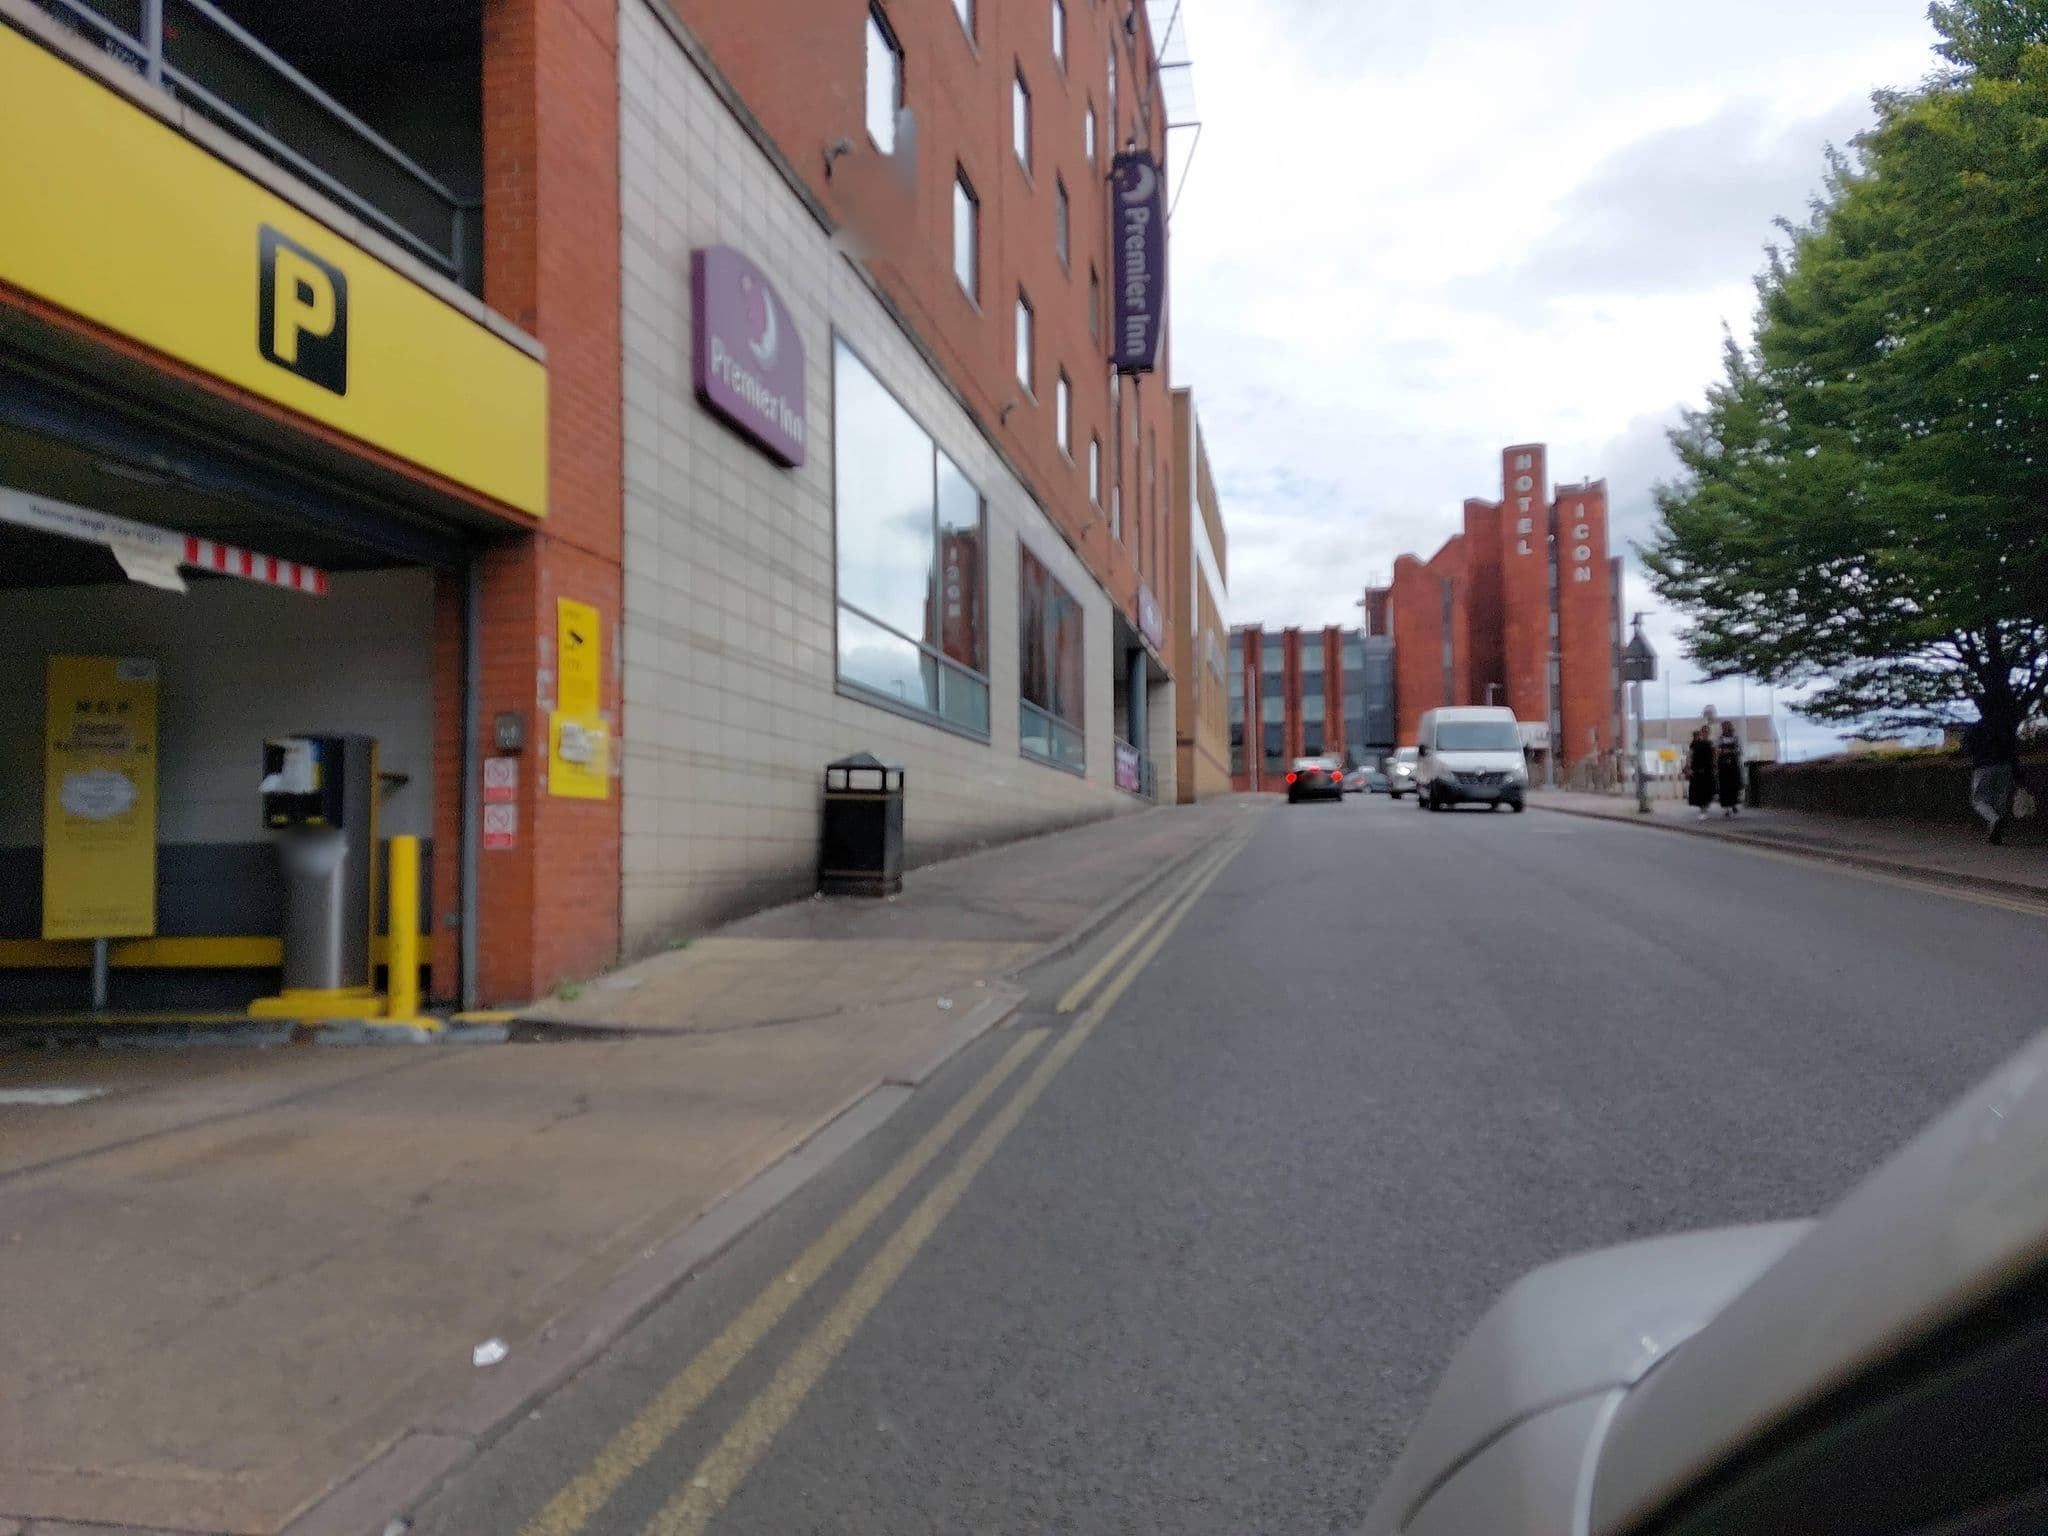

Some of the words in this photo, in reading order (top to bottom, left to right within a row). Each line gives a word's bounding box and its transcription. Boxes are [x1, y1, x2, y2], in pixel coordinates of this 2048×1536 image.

[273, 244, 336, 365] P
[1124, 206, 1151, 314] Premier
[710, 333, 779, 421] Premier
[779, 394, 803, 442] Inn
[1125, 313, 1151, 357] Inn
[1514, 453, 1534, 556] HOTEL
[1572, 502, 1592, 583] ICON
